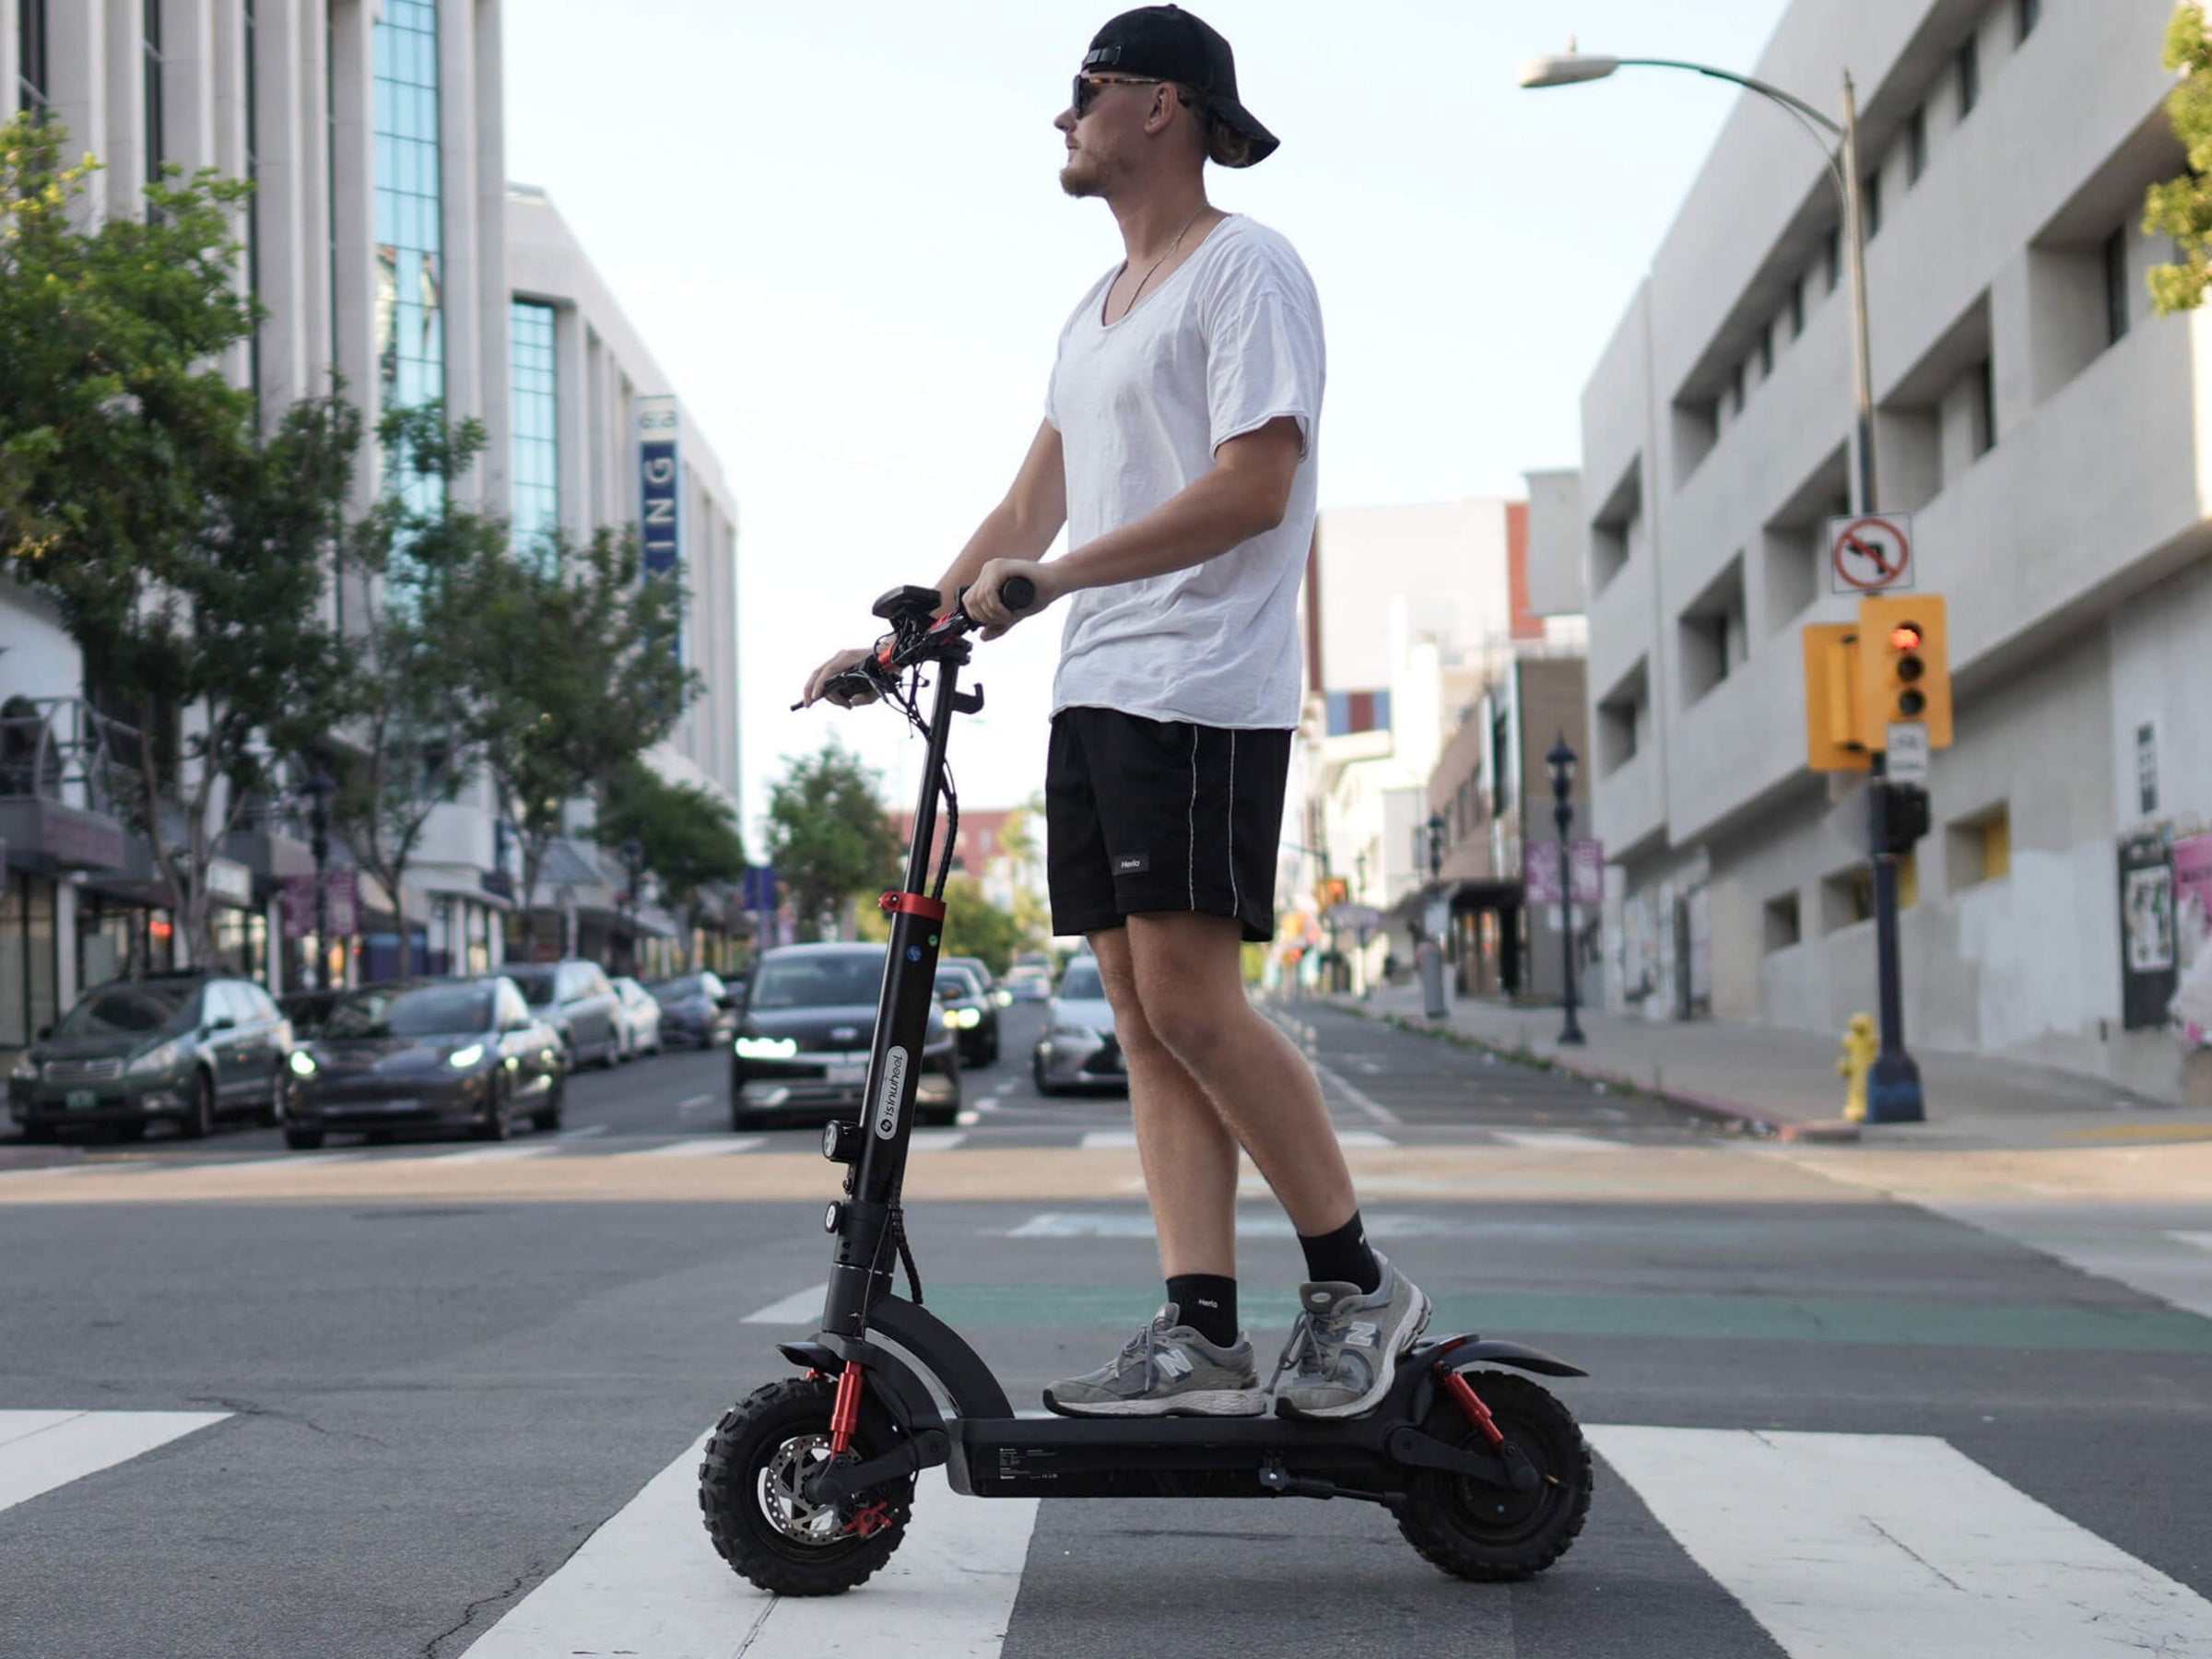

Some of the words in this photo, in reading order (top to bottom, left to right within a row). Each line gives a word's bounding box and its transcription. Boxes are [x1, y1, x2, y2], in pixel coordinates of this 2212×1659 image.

[885, 1054, 903, 1117] isinwheel
[1345, 1321, 1377, 1347] N
[1155, 1349, 1194, 1377] N
